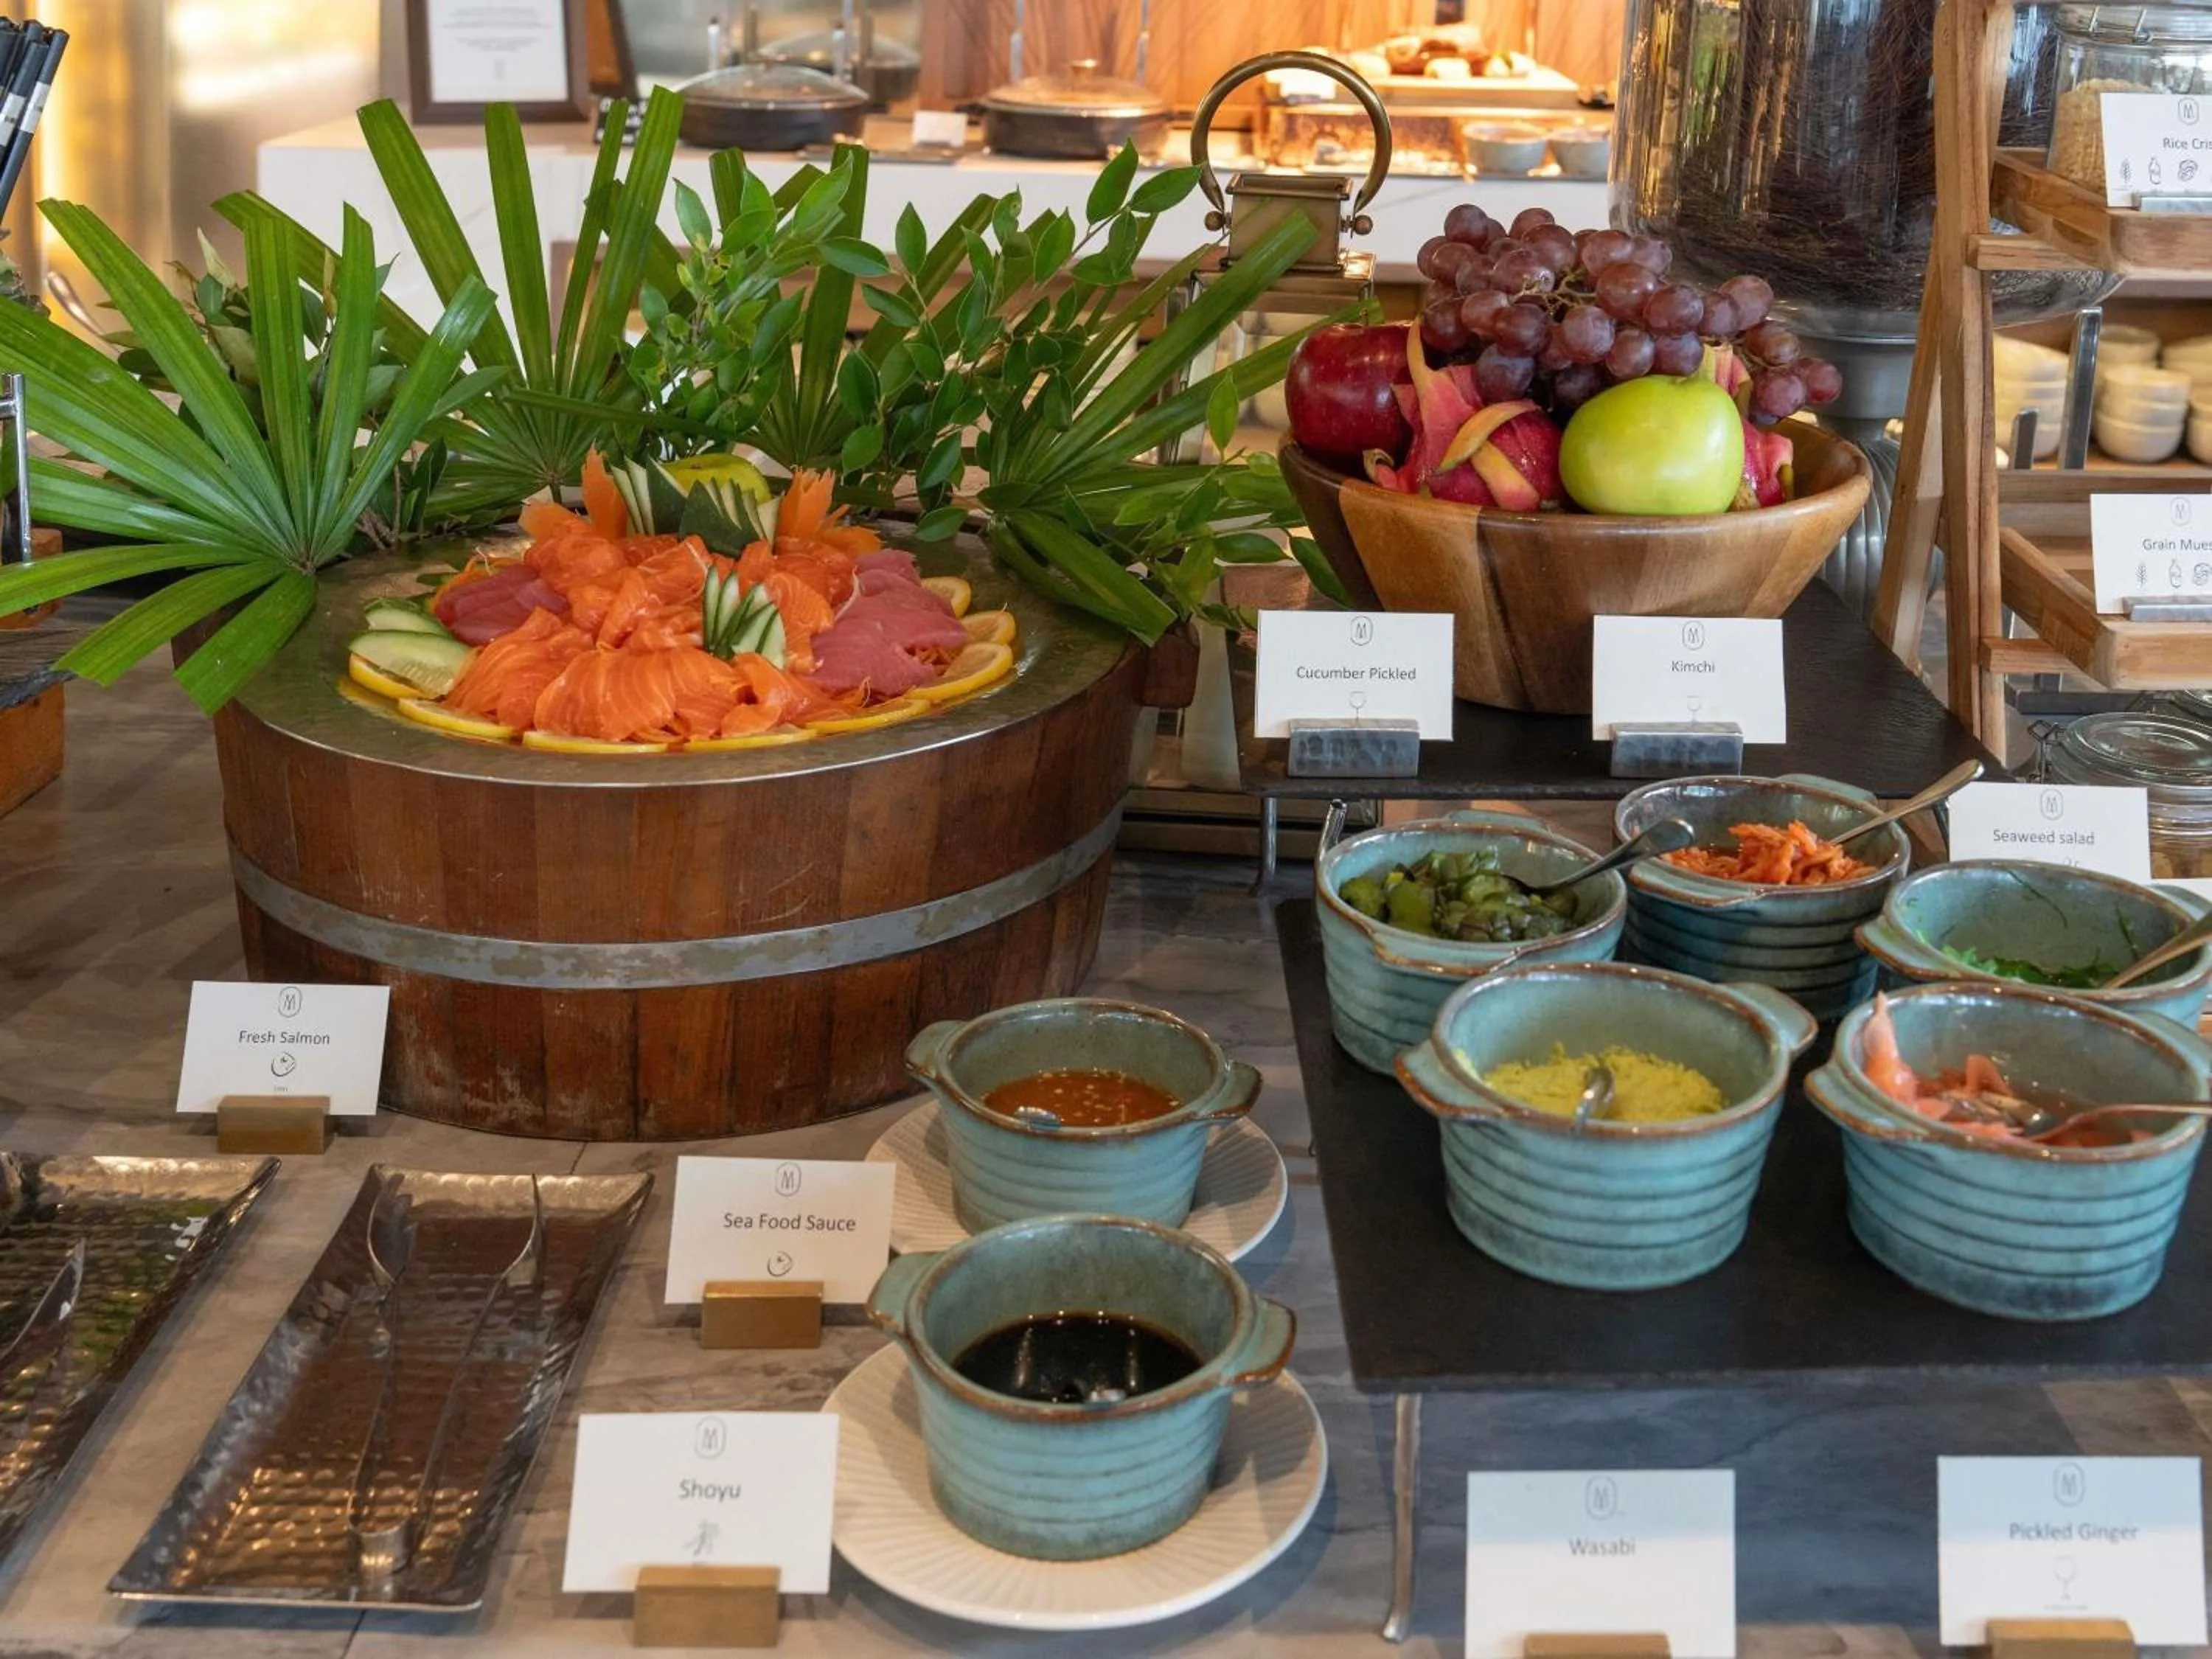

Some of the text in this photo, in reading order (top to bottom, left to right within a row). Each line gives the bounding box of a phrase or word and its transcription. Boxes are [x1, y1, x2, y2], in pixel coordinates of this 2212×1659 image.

[2163, 137, 2188, 150] Rice
[2142, 538, 2176, 551] Grain
[1296, 666, 1416, 681] Cucumber Pickled
[1672, 660, 1715, 672] Kimchi
[1993, 830, 2095, 845] Seaweed salad
[238, 1030, 330, 1045] Fresh Salmon
[723, 1212, 857, 1231] Sea Food Sauce
[678, 1479, 742, 1503] Shoyu
[2009, 1522, 2139, 1545] Pickled Ginger
[1568, 1539, 1636, 1557] Wasabi
